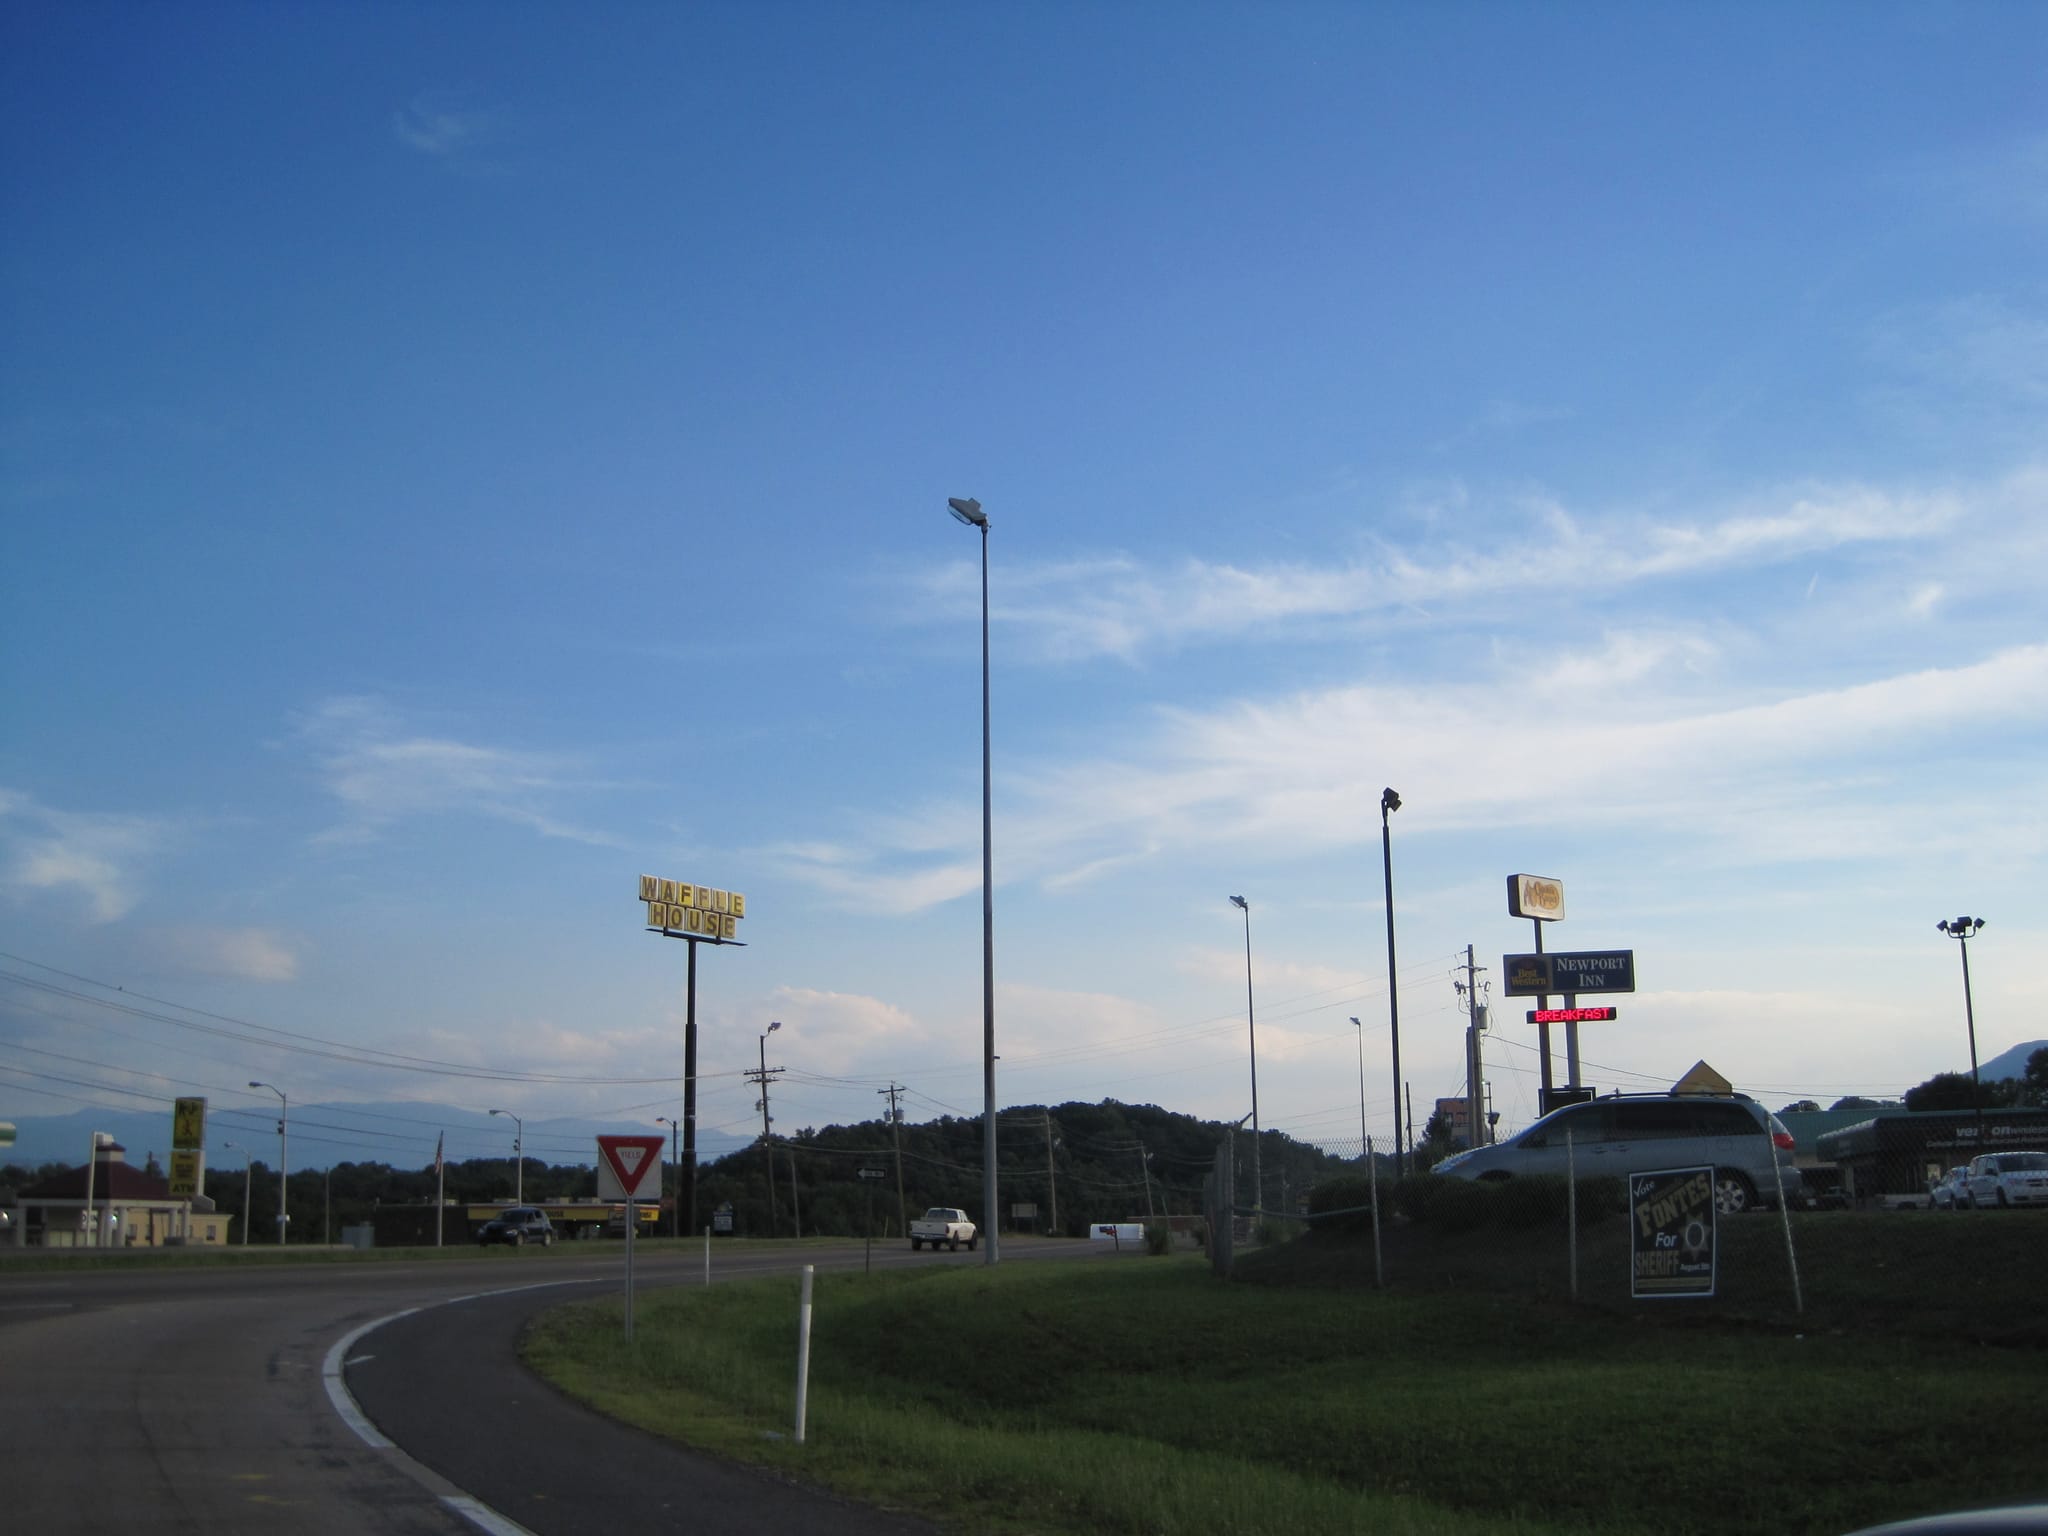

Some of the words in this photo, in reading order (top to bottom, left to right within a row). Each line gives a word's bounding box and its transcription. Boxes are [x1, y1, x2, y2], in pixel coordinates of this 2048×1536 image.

[642, 876, 743, 912] WAFFLE
[653, 903, 733, 936] HOUSE
[1557, 957, 1626, 971] NEWPORT
[1511, 976, 1546, 986] Western
[1579, 973, 1605, 987] INN
[1535, 1008, 1610, 1022] BREAKFAST
[172, 1183, 196, 1193] ATM
[1633, 1177, 1655, 1199] Vote
[1635, 1173, 1711, 1238] FONTES
[1656, 1232, 1678, 1248] For
[1635, 1249, 1681, 1276] SHERIFF
